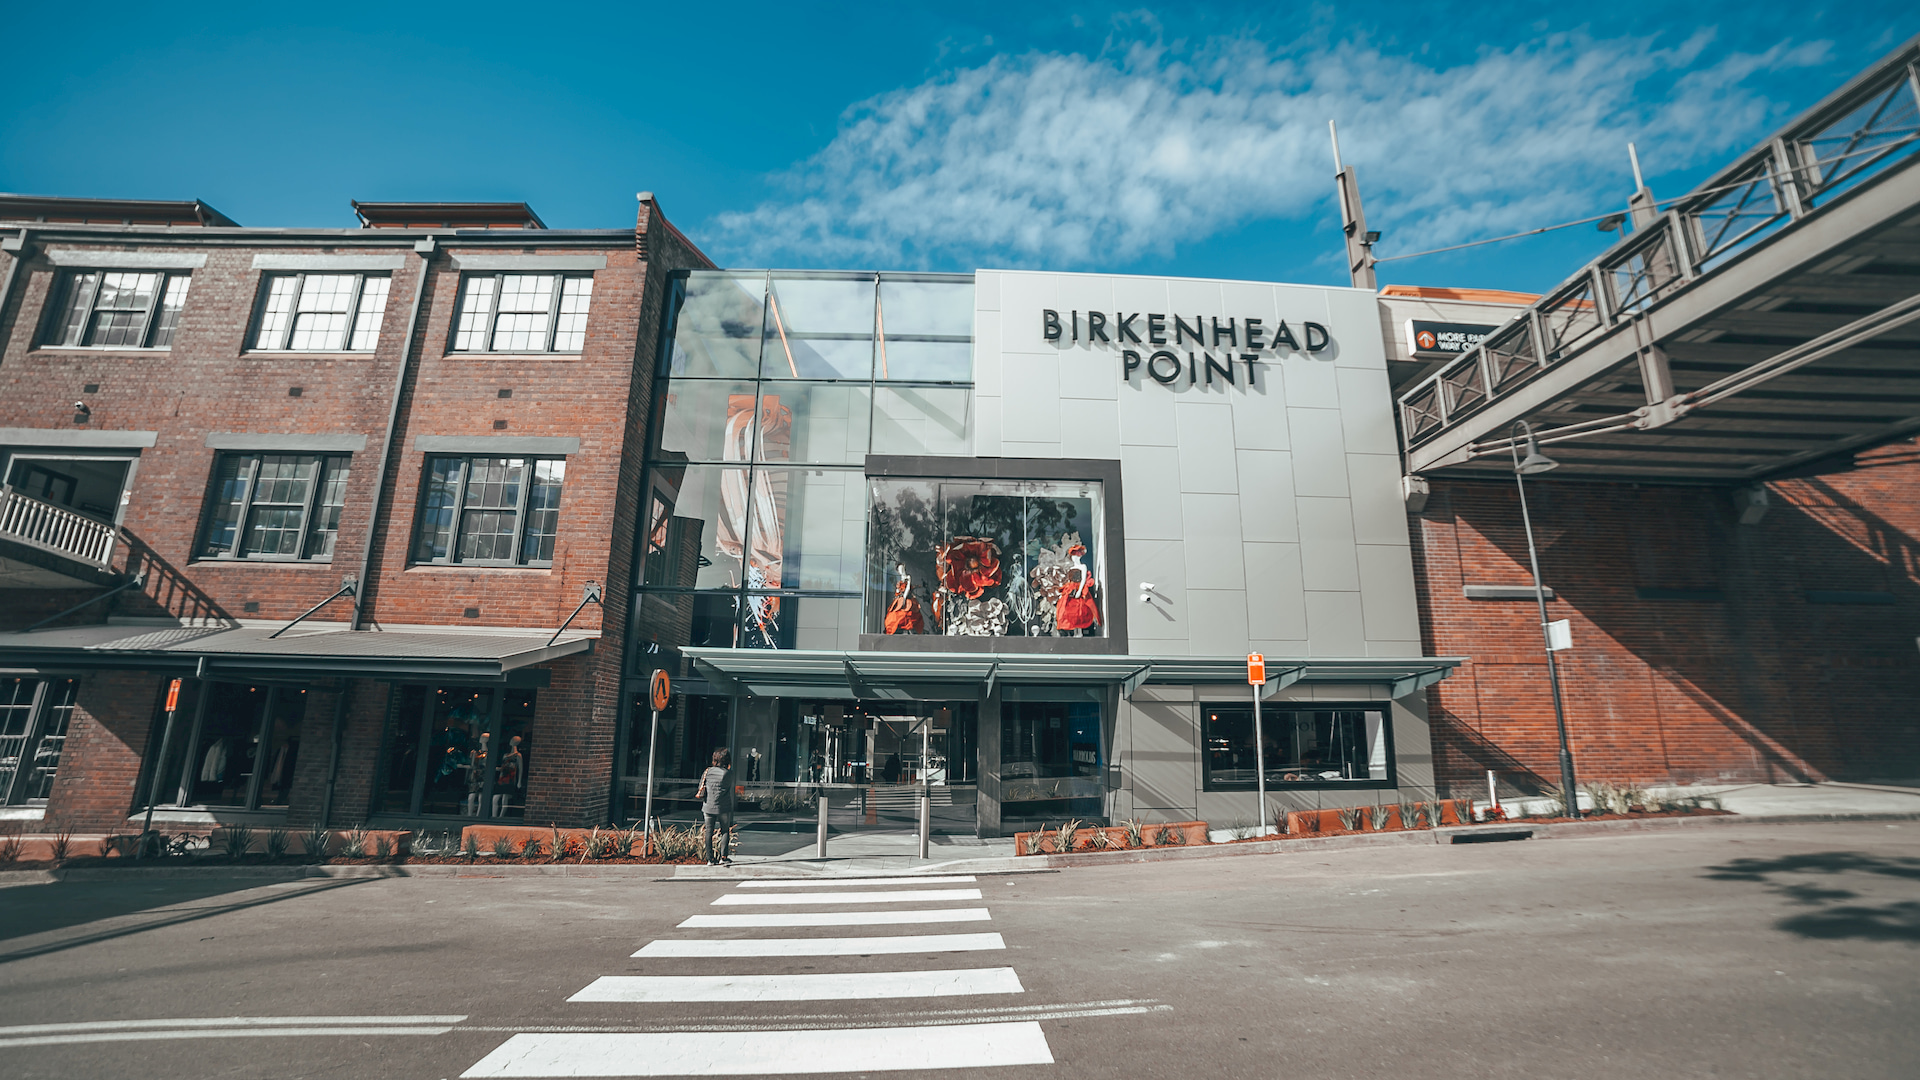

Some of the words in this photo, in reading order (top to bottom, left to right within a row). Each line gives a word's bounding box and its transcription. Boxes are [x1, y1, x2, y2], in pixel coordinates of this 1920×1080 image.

[1043, 308, 1330, 352] BIRKENHEAD
[1437, 332, 1467, 342] MORE
[1437, 341, 1461, 351] WAY
[1122, 350, 1259, 386] POINT
